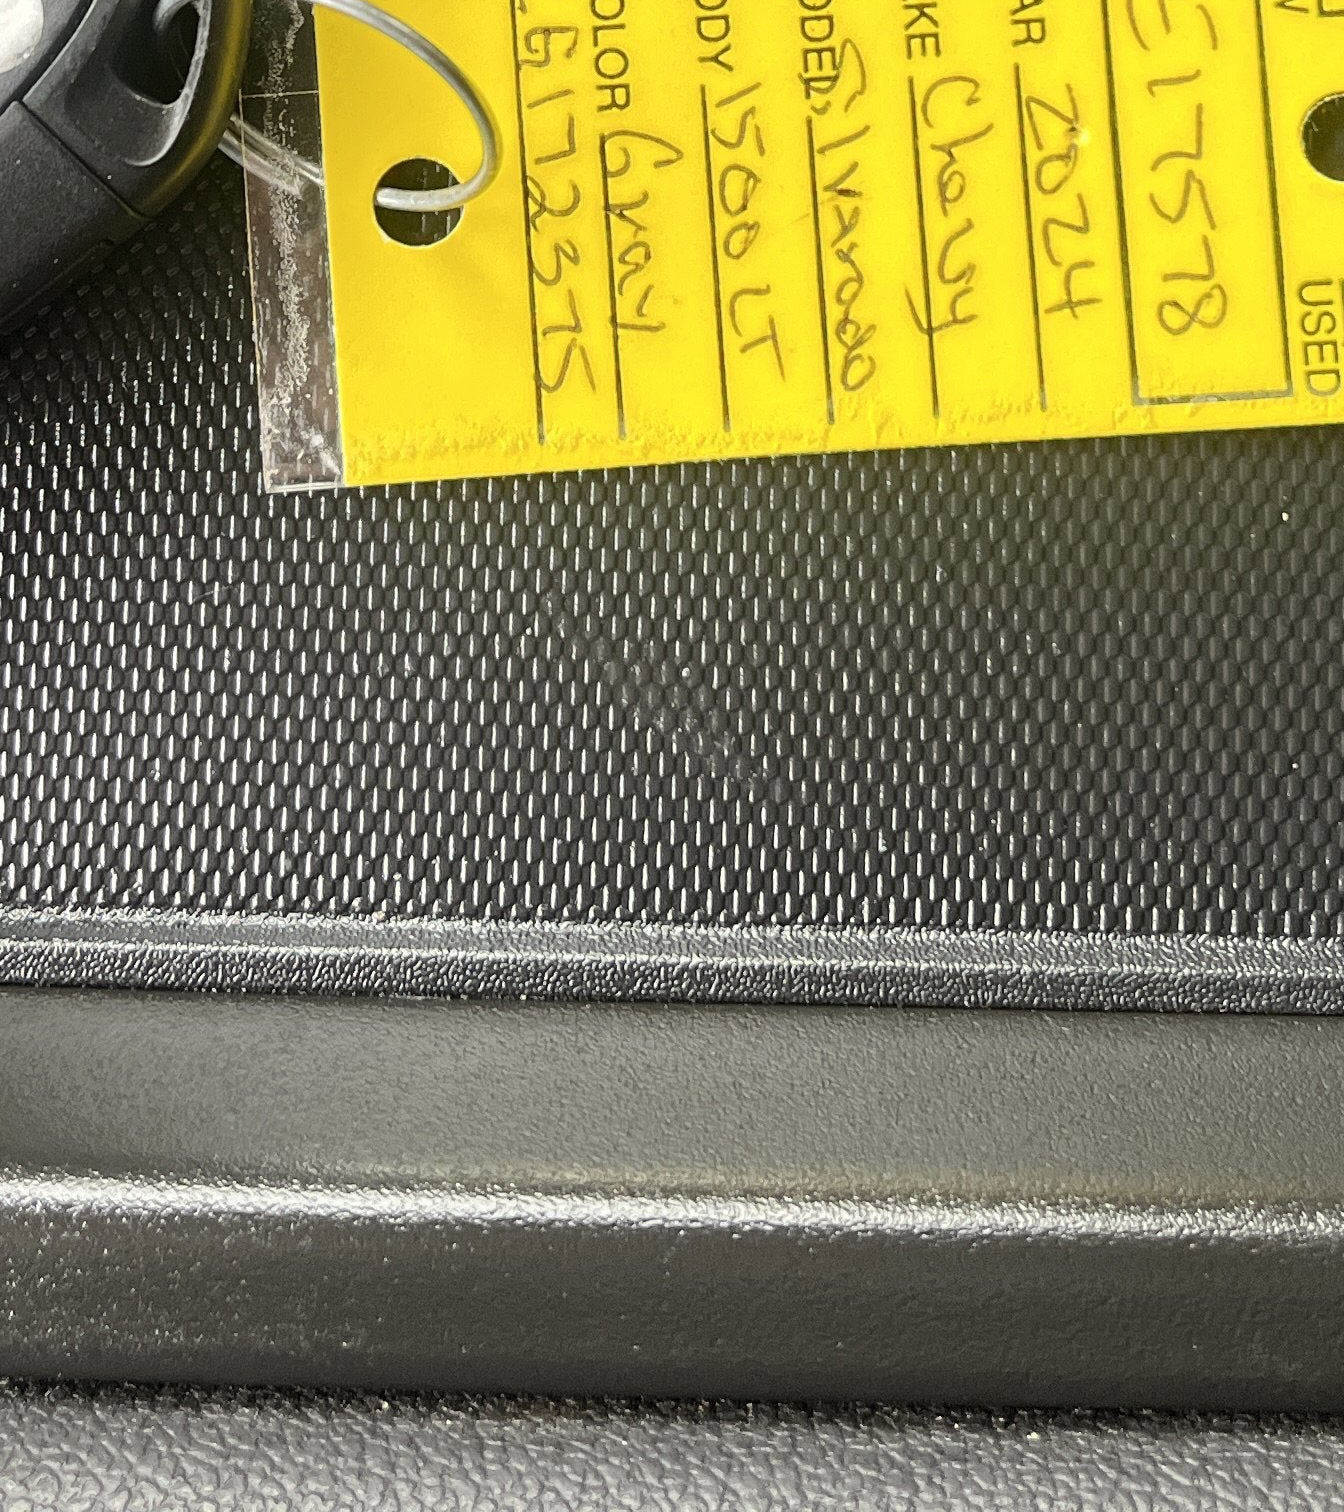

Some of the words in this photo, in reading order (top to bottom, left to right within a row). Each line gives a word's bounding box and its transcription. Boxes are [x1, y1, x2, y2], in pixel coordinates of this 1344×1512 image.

[603, 129, 684, 333] Gray
[711, 81, 762, 260] 1500
[1025, 83, 1103, 321] 2024
[729, 284, 785, 383] LT
[1298, 279, 1342, 397] USED
